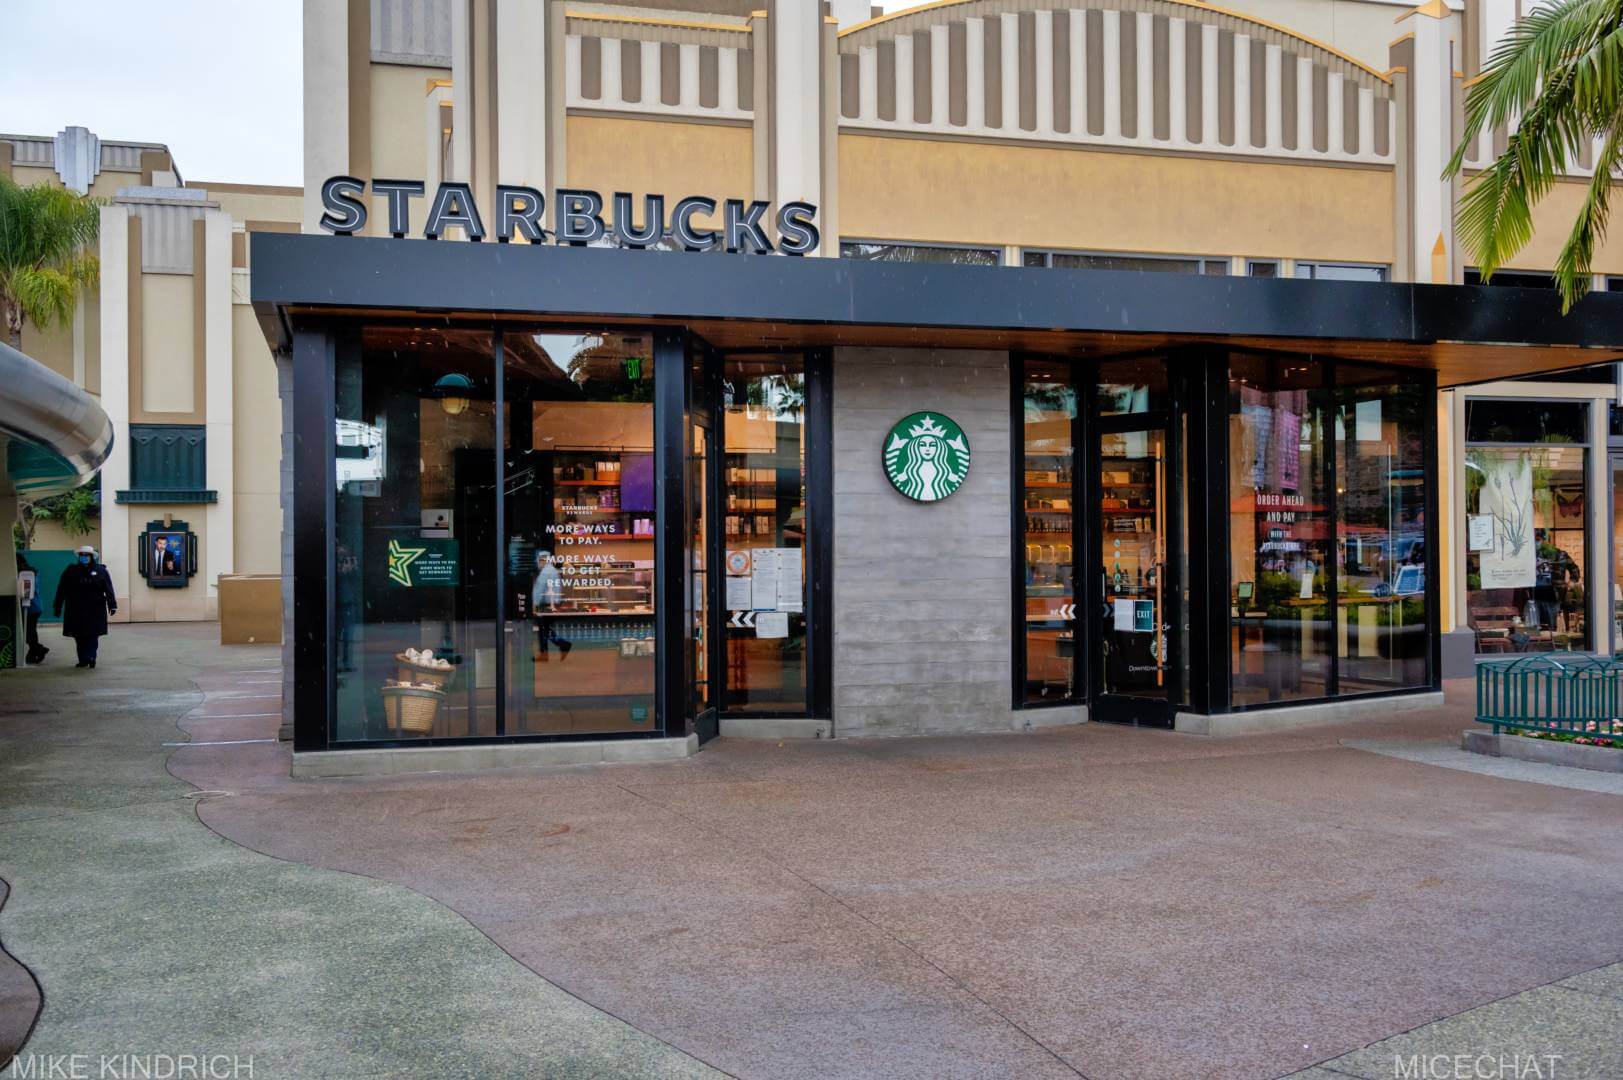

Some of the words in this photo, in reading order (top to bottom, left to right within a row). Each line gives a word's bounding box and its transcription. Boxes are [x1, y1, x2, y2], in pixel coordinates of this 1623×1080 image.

[320, 175, 820, 256] STARBUCKS
[1257, 494, 1280, 505] ORDER
[1282, 495, 1304, 506] AHEAD
[1267, 511, 1281, 522] AND
[1283, 511, 1296, 522] PAY
[545, 524, 579, 533] MORE
[583, 524, 616, 533] WAYS
[560, 537, 574, 545] TO
[578, 537, 602, 545] PAY.
[546, 555, 579, 563] MORE
[583, 555, 616, 563] WAYS
[562, 567, 576, 575] TO
[580, 567, 601, 575] GET
[547, 579, 615, 587] REWARDED.
[1136, 610, 1150, 619] EXIT
